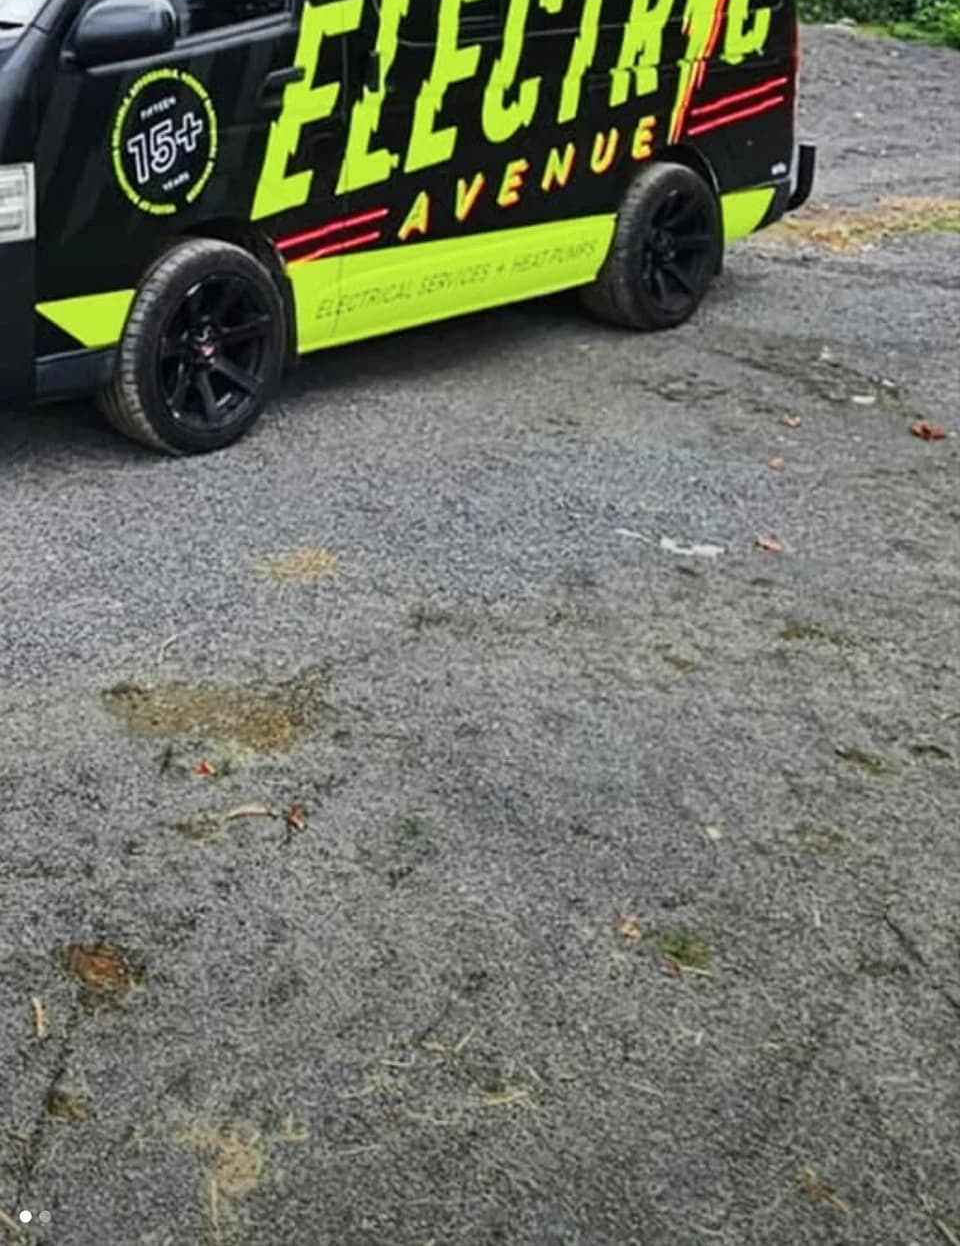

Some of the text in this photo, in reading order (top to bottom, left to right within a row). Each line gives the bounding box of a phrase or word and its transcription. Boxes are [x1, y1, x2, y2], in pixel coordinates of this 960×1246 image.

[126, 111, 203, 185] 15+
[397, 115, 657, 241] AVENUE
[314, 279, 413, 320] ELECTRICAL
[416, 262, 492, 297] SERVICES
